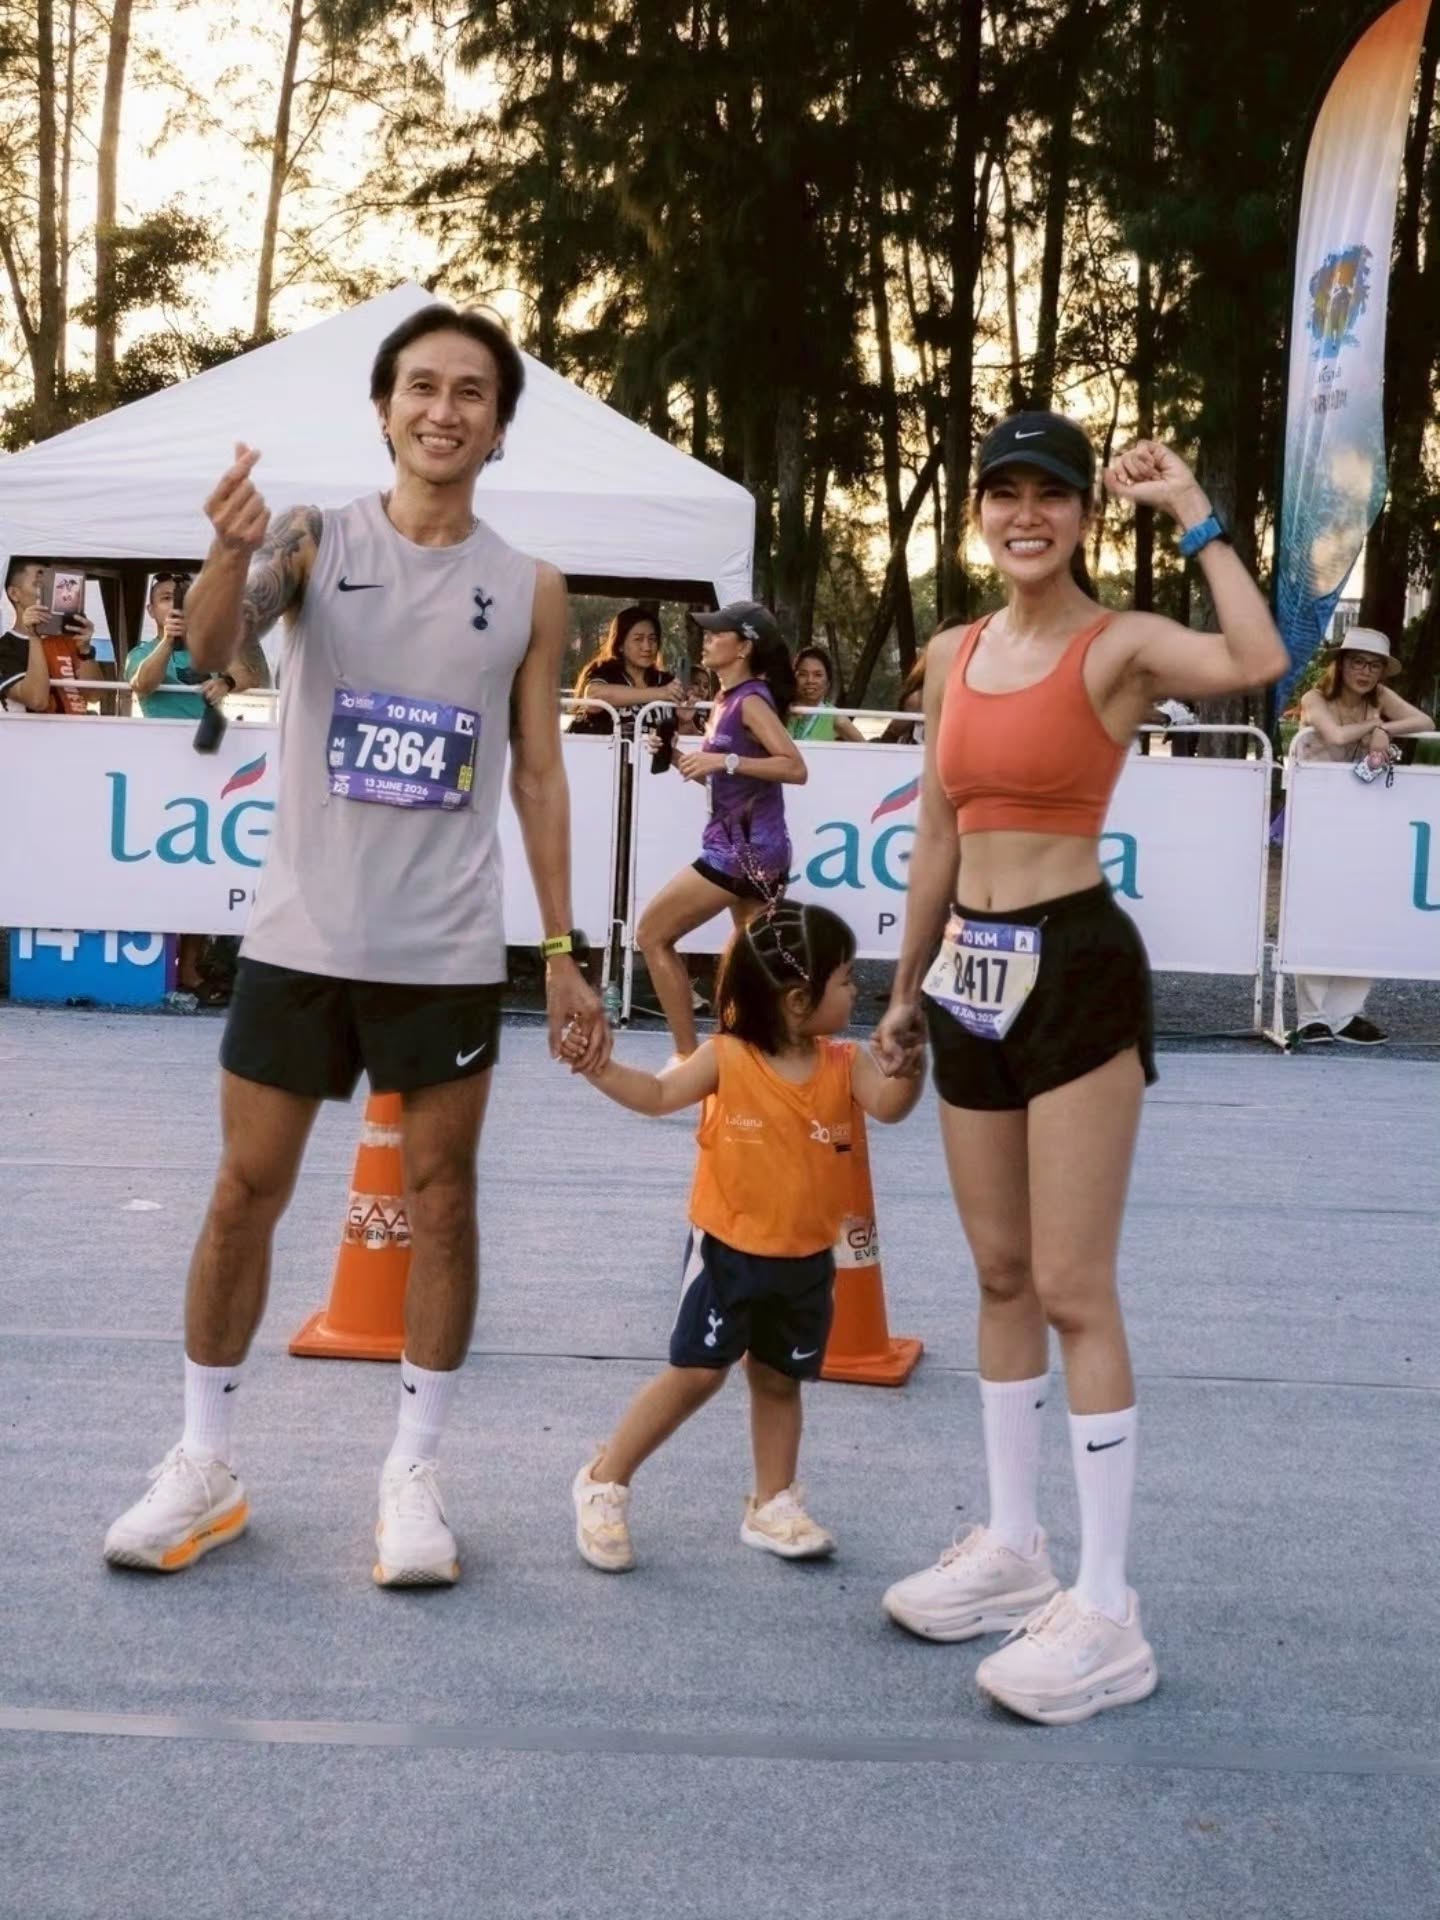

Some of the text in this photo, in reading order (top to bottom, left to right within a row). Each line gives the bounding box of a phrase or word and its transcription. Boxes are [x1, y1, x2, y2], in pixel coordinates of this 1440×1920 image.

[387, 704, 405, 719] 10
[408, 708, 438, 725] KM
[333, 737, 346, 749] M
[355, 723, 446, 780] 7364
[376, 780, 403, 791] JUNE
[404, 784, 429, 796] 2026
[961, 930, 998, 947] 10 KM
[1019, 937, 1028, 948] A
[953, 951, 1009, 1004] 8417
[809, 1119, 830, 1144] 20
